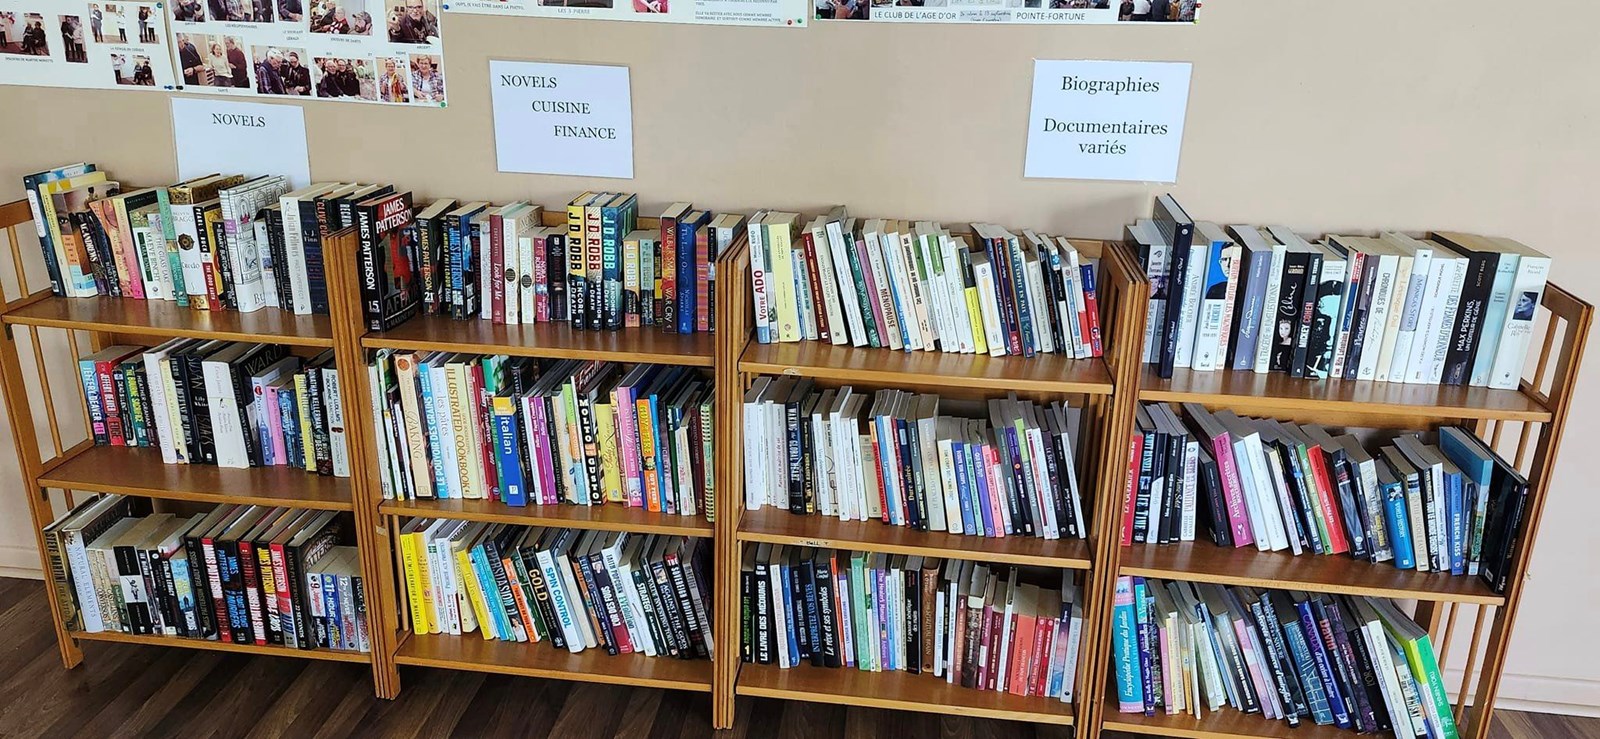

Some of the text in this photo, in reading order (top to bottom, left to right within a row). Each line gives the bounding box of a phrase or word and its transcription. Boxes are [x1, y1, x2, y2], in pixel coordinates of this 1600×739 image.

[938, 12, 956, 20] D'OR
[1016, 12, 1085, 20] POINTE-FORTUNE
[501, 75, 557, 89] NOVELS
[1061, 76, 1160, 94] Biographies
[212, 113, 266, 128] NOVELS
[532, 100, 590, 115] CUISINE
[554, 125, 616, 140] FINANCE
[1043, 118, 1168, 135] Documentaires
[1078, 140, 1127, 155] variés
[317, 202, 325, 223] CLIVE
[375, 208, 412, 234] PATTERSON
[383, 197, 404, 214] JAMES
[145, 232, 156, 258] MAEVE
[221, 246, 229, 273] BURTON
[358, 212, 376, 290] JAMES PATTERSON
[420, 226, 433, 291] JAMES PATTERSON
[449, 229, 463, 290] JAMES PATTERSON
[570, 239, 582, 271] ROBB
[588, 239, 600, 270] ROBB
[603, 239, 615, 269] ROBB
[666, 226, 675, 281] WILBUR SMITH
[626, 263, 636, 287] ROBB
[753, 270, 765, 294] ADO
[1378, 272, 1390, 307] CHRONIQUES
[576, 281, 584, 314] ENCORE
[665, 288, 674, 324] WAR CRY
[880, 288, 896, 328] MÉNOPAUSE
[1298, 302, 1314, 348] MICKEY COHEN
[1456, 300, 1475, 352] MAX PERKINS,
[83, 367, 101, 420] JEFFERY DEAVER
[137, 375, 151, 427] HEATHER GRAHAM
[187, 355, 214, 445] SUSAN ISAACS
[308, 368, 322, 429] JONATHAN KELLERMAN
[424, 396, 436, 425] GRAINS
[437, 395, 450, 437] les pâtes
[447, 368, 470, 489] ILLUSTRATED COOKBOOK
[579, 399, 593, 443] MOLTO
[639, 405, 649, 426] GUY
[407, 411, 423, 459] BAKING
[501, 416, 513, 455] italian
[787, 408, 800, 483] WAKING GLOBAL HEART
[433, 442, 443, 474] POUVOIR
[588, 457, 600, 500] GUSTO
[1223, 460, 1241, 518] Archives secrètes
[1134, 494, 1150, 530] ICE TIME
[1395, 502, 1403, 519] WORLD
[1453, 513, 1461, 540] FRENCH
[45, 533, 66, 583] STEVE MARTINI
[202, 545, 223, 599] JAMES PATTERSON
[218, 549, 230, 582] PATTERSON
[227, 556, 239, 575] JAMES
[257, 548, 275, 594] JAMES PATTERSON
[271, 549, 286, 592] JAMES PATTERSON
[579, 558, 589, 577] LIFE
[606, 554, 622, 593] FAITH POPCORN
[75, 547, 97, 618] NATURAL ELEMENTS
[162, 560, 175, 597] STOLEN LEGACY
[489, 554, 513, 607] PERSUASION
[529, 569, 548, 602] GOLD
[229, 597, 241, 629] MURDERS
[247, 587, 265, 641] JAMES PATTERSON
[327, 597, 337, 617] HOUR
[545, 567, 571, 629] SPIN CONTROL
[601, 586, 617, 614] DES FOUS
[637, 583, 653, 613] STRATEGY
[671, 566, 698, 631] SOVEREIGN INDIVIDUAL
[819, 586, 831, 614] symboles
[185, 611, 197, 631] VICIOUS
[651, 596, 668, 628] INVESTING
[663, 628, 675, 646] TODAY
[660, 584, 674, 614] AGAINST
[676, 628, 688, 649] GODS
[758, 580, 768, 661] LE LIVRE DES MÉDIUMS
[804, 584, 820, 653] INTERPRÉTEZ VOS RÊVES
[1302, 614, 1321, 652] CANADA
[823, 631, 833, 646] rêve
[824, 645, 834, 656] Le
[1124, 662, 1133, 697] Encyclopédie
